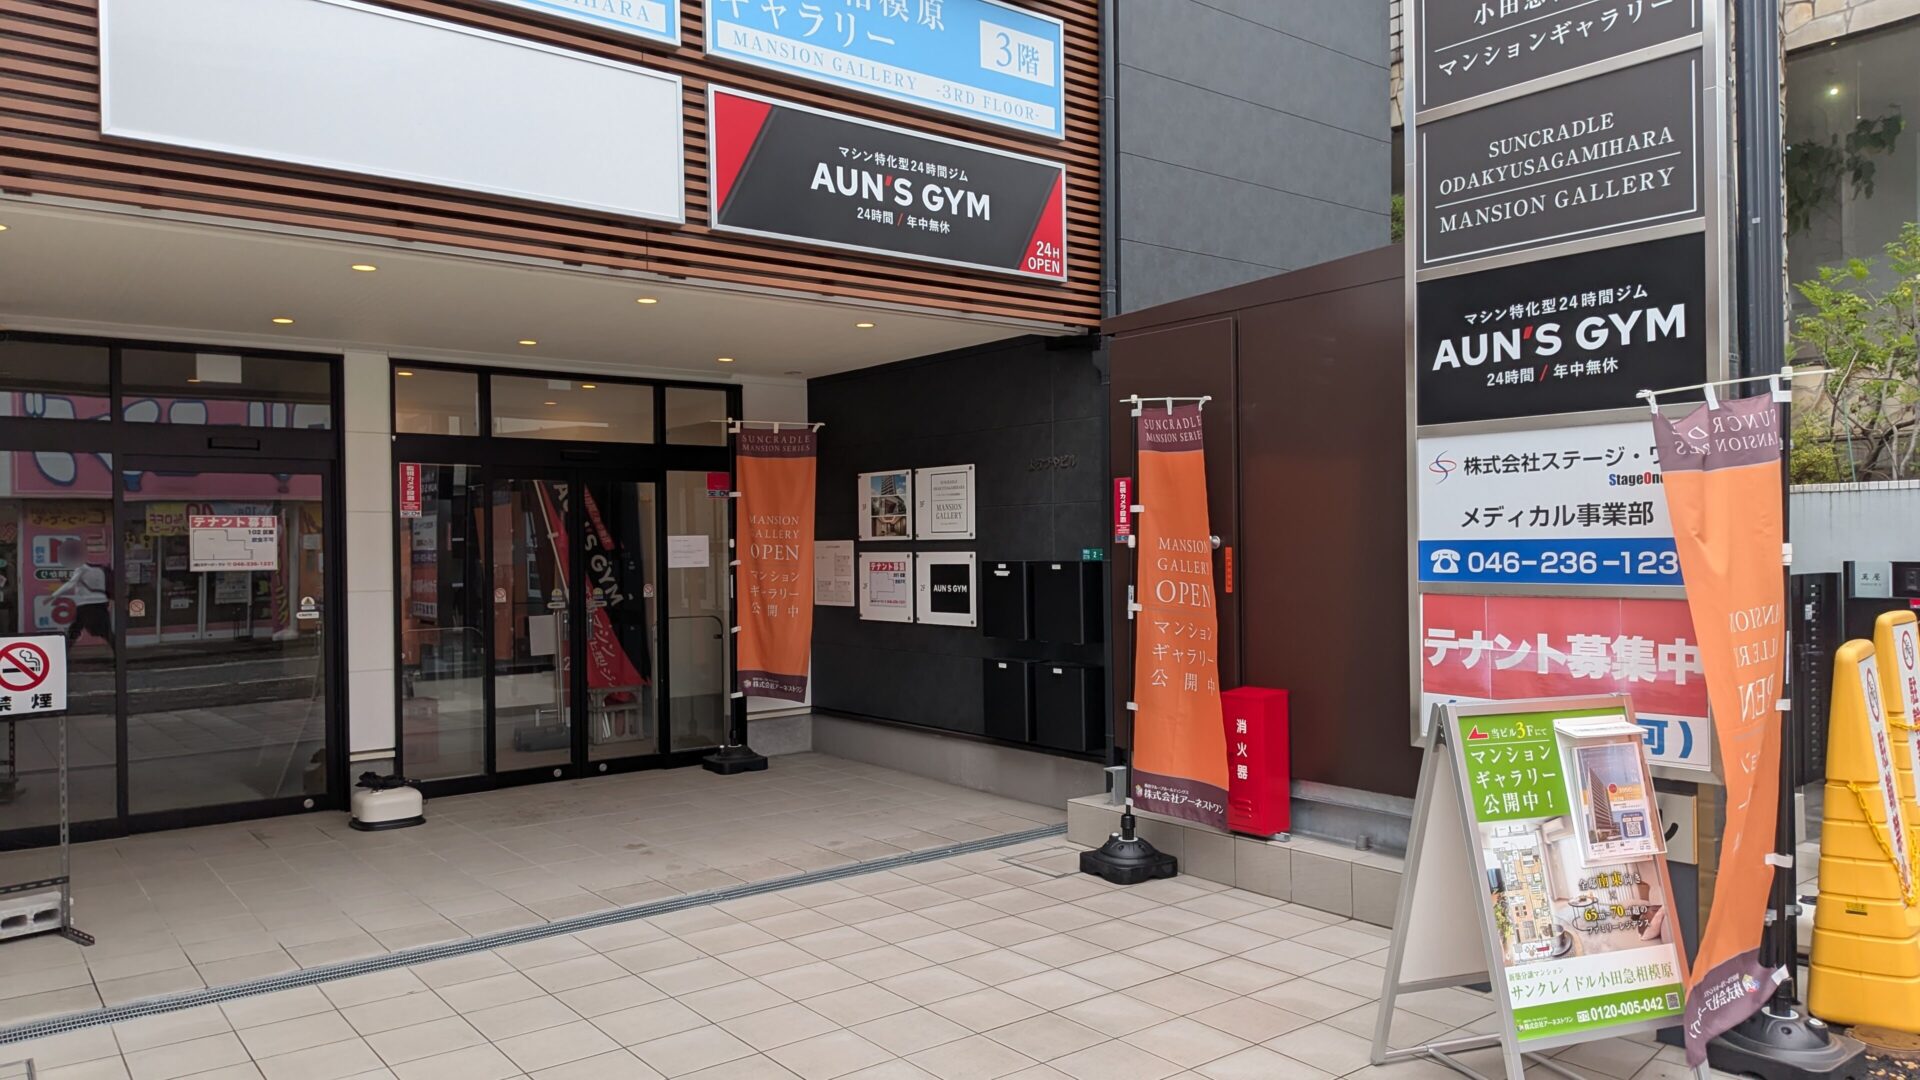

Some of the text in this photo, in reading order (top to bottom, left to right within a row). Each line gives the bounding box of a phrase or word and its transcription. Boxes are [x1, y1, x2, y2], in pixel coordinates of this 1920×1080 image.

[1438, 0, 1674, 77] マンションギャラリー
[733, 30, 824, 67] MANSION
[832, 56, 917, 91] GALLERY
[994, 32, 1040, 77] 3階
[1488, 111, 1615, 158] SUNCRADLE
[838, 146, 969, 183] マシン特化型24時間ジム
[1439, 126, 1675, 196] ODAKYUSAGAMIHARA
[810, 162, 990, 221] AUN'S GYM
[1439, 166, 1675, 234] MANSION GALLERY
[857, 206, 894, 225] 24時間
[906, 214, 951, 235] 年中無休
[1036, 240, 1060, 258] 24H
[1027, 256, 1060, 274] OPEN
[1464, 284, 1648, 325] マシン特化型24時間ジム
[1432, 303, 1686, 371] AUN'S GYM
[1486, 366, 1534, 387] 24時間
[1553, 357, 1619, 379] 年中無休
[1143, 414, 1203, 431] SUNCRADLE
[1178, 429, 1203, 442] SERIE
[1460, 502, 1654, 529] メディカル事業部
[750, 544, 800, 560] OPEN
[953, 585, 968, 593] GYM
[1156, 579, 1211, 608] OPEN
[1154, 620, 1212, 641] マンション
[1152, 643, 1215, 667] ギャラリー
[1424, 627, 1704, 686] テナント募集中
[1491, 721, 1548, 740] 当ビル3Fにて
[1236, 718, 1248, 780] 消火器
[1470, 745, 1551, 764] マンション
[1476, 768, 1556, 789] ギャラリー
[1143, 788, 1224, 814] 株式会社アーネストワン
[1511, 961, 1674, 1002] サンクレイドル小田急相模原
[1591, 996, 1665, 1023] 0120-005-042
